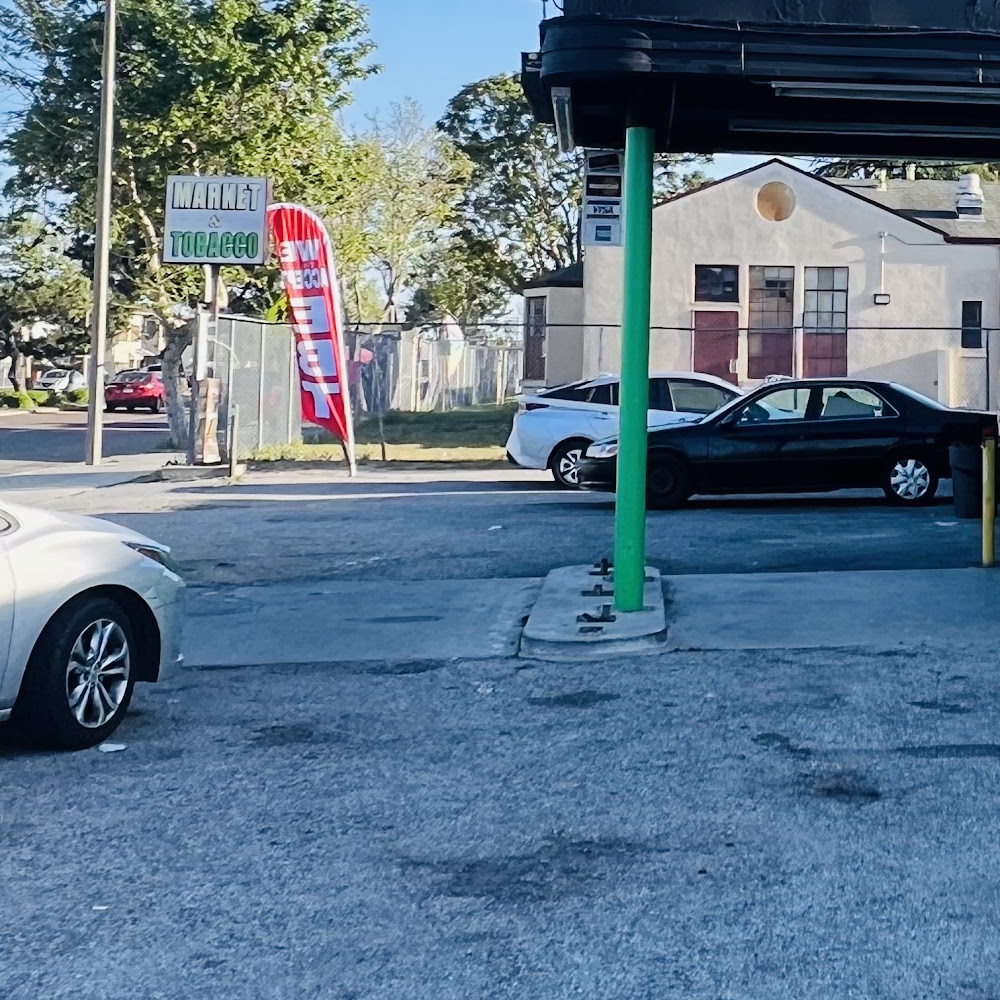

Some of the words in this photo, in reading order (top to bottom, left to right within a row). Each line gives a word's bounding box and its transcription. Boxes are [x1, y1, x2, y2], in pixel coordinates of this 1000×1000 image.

[172, 181, 262, 211] MARKET
[593, 205, 614, 214] VISA
[208, 214, 222, 229] &
[170, 231, 259, 259] TOBACCO
